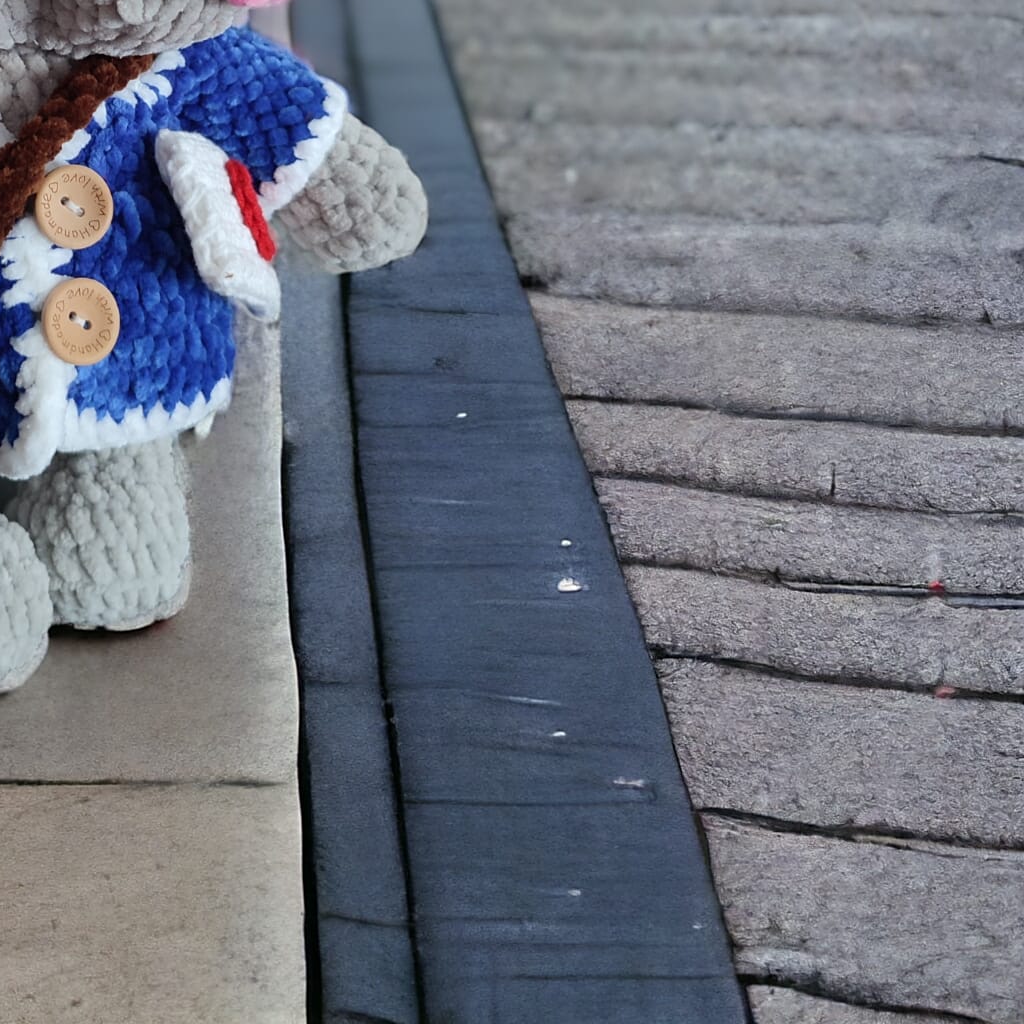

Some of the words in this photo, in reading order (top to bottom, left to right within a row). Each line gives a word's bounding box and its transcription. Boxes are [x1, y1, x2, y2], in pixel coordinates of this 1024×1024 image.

[61, 173, 92, 188] love
[41, 193, 92, 239] Handmade
[91, 183, 107, 216] with
[66, 287, 94, 299] love
[52, 314, 104, 355] Handmade
